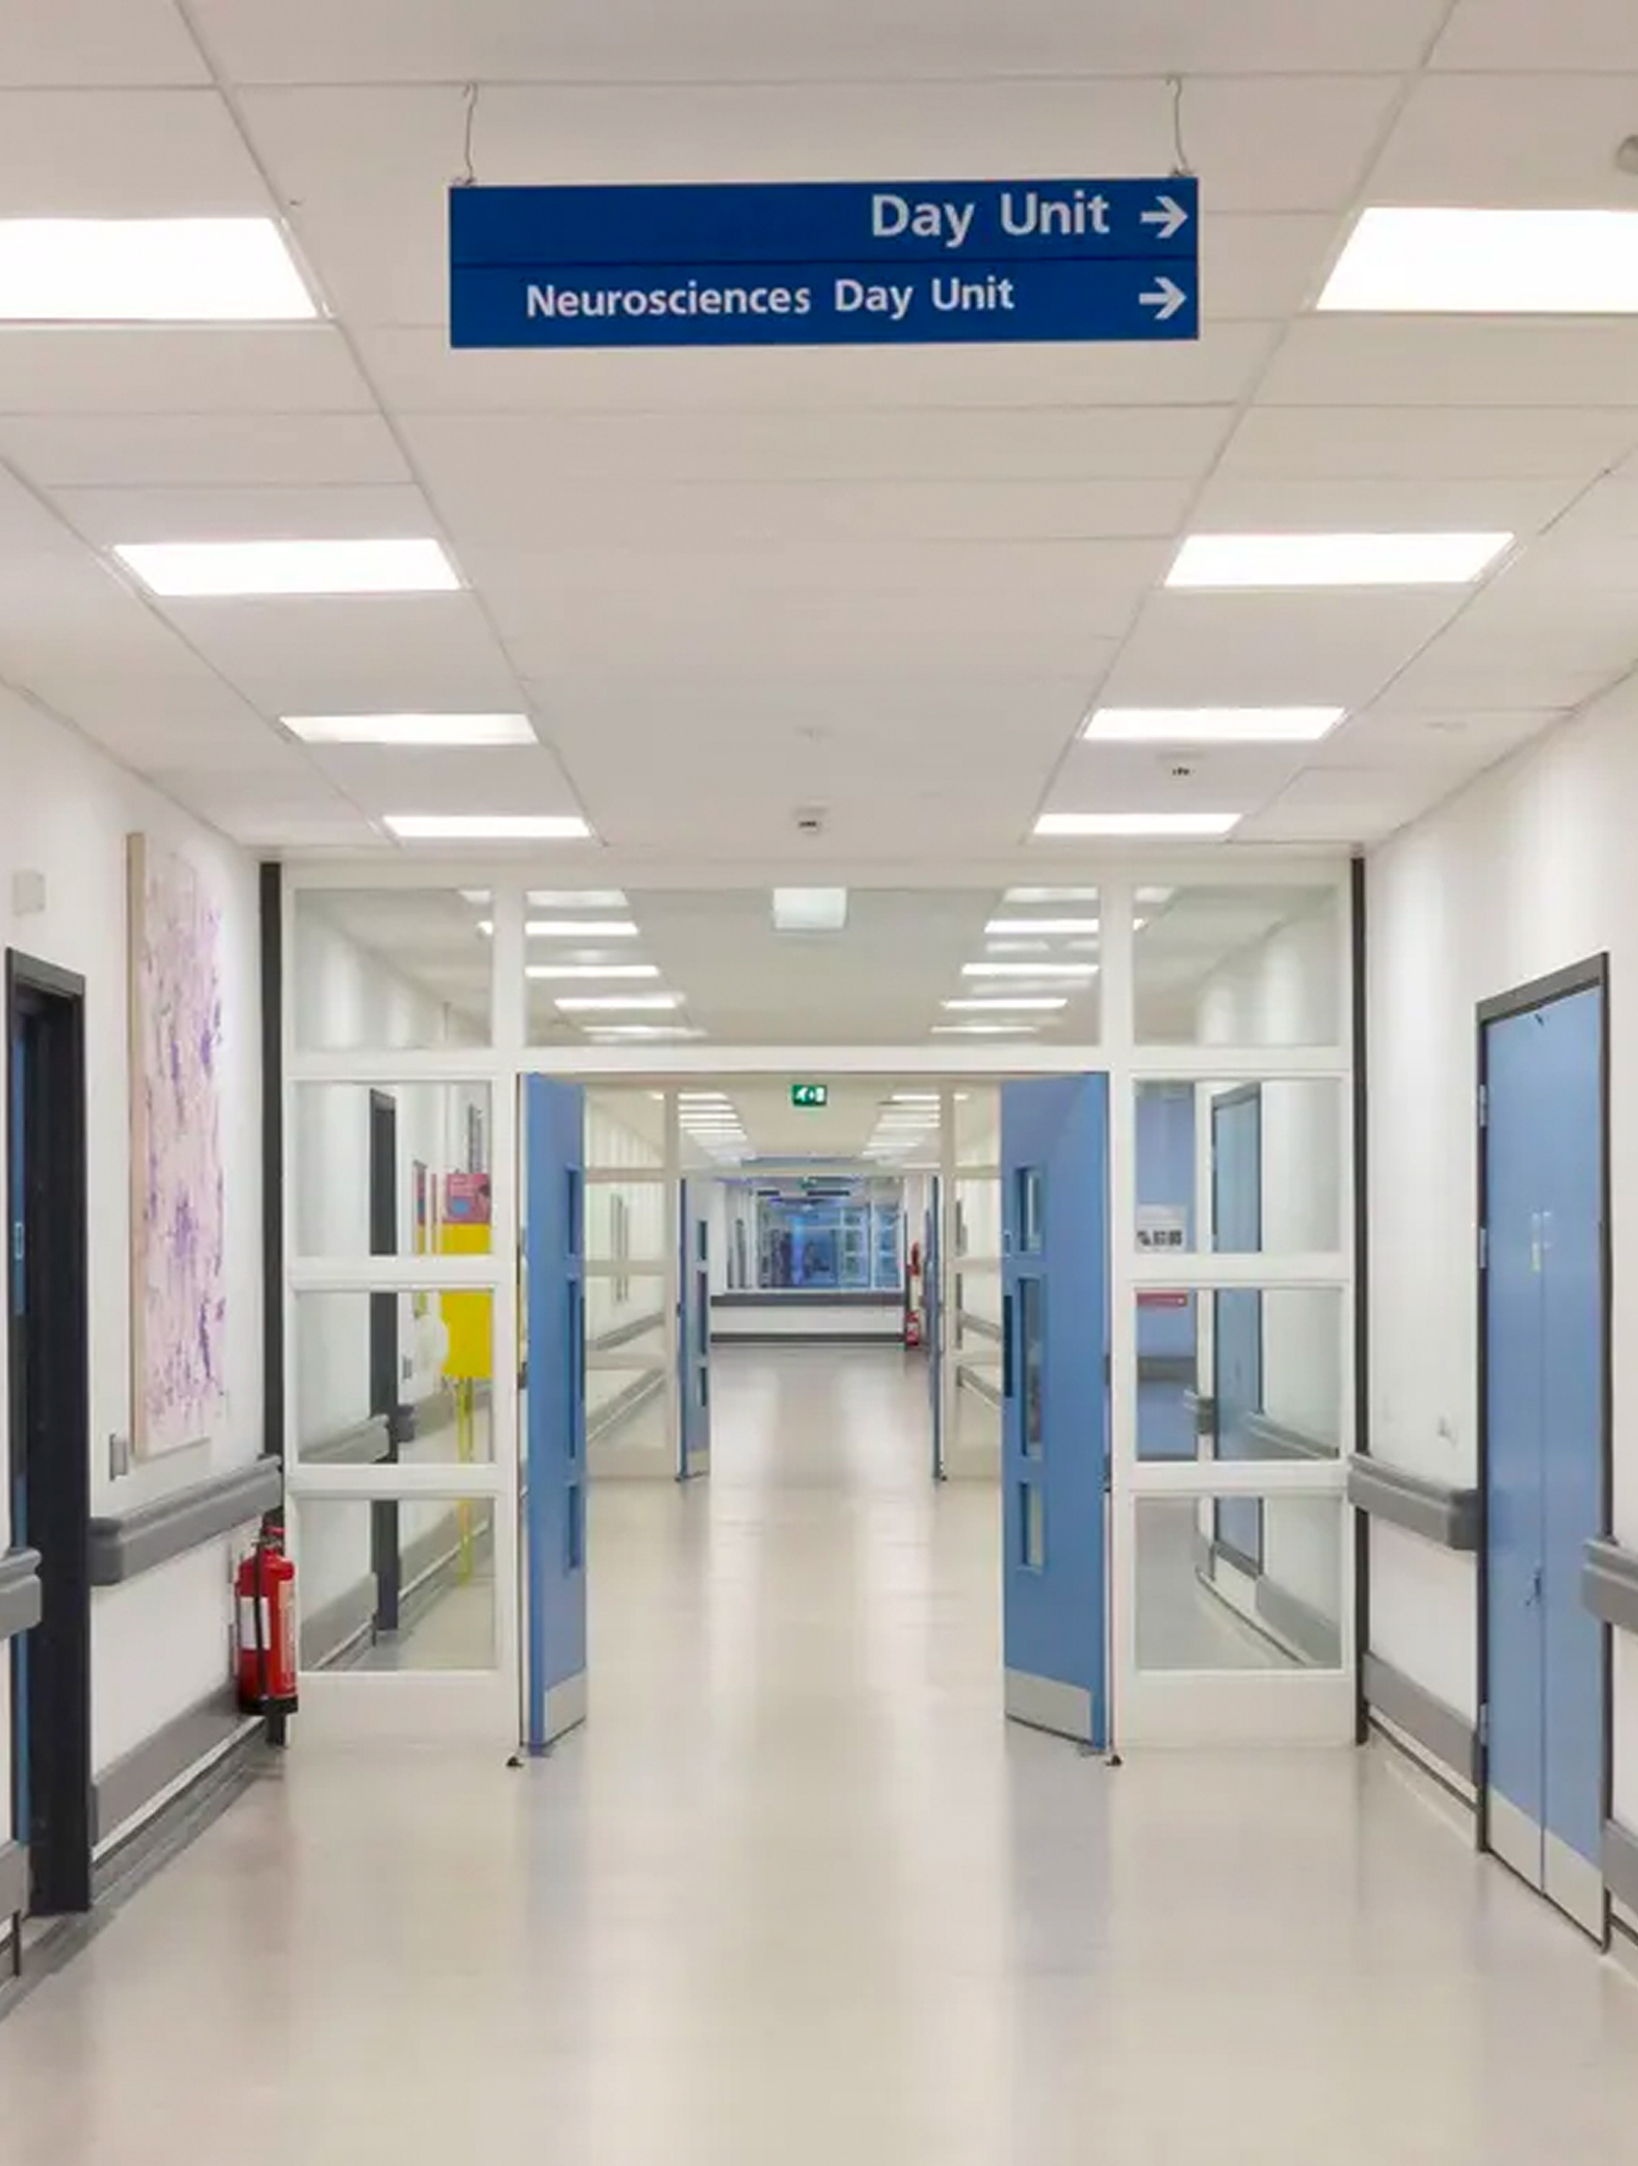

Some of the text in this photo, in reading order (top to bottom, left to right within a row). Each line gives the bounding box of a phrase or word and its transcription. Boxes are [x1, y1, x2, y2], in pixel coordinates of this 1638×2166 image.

[871, 191, 1110, 248] Day Unit
[526, 275, 1015, 320] Neurosciences Day Unit
